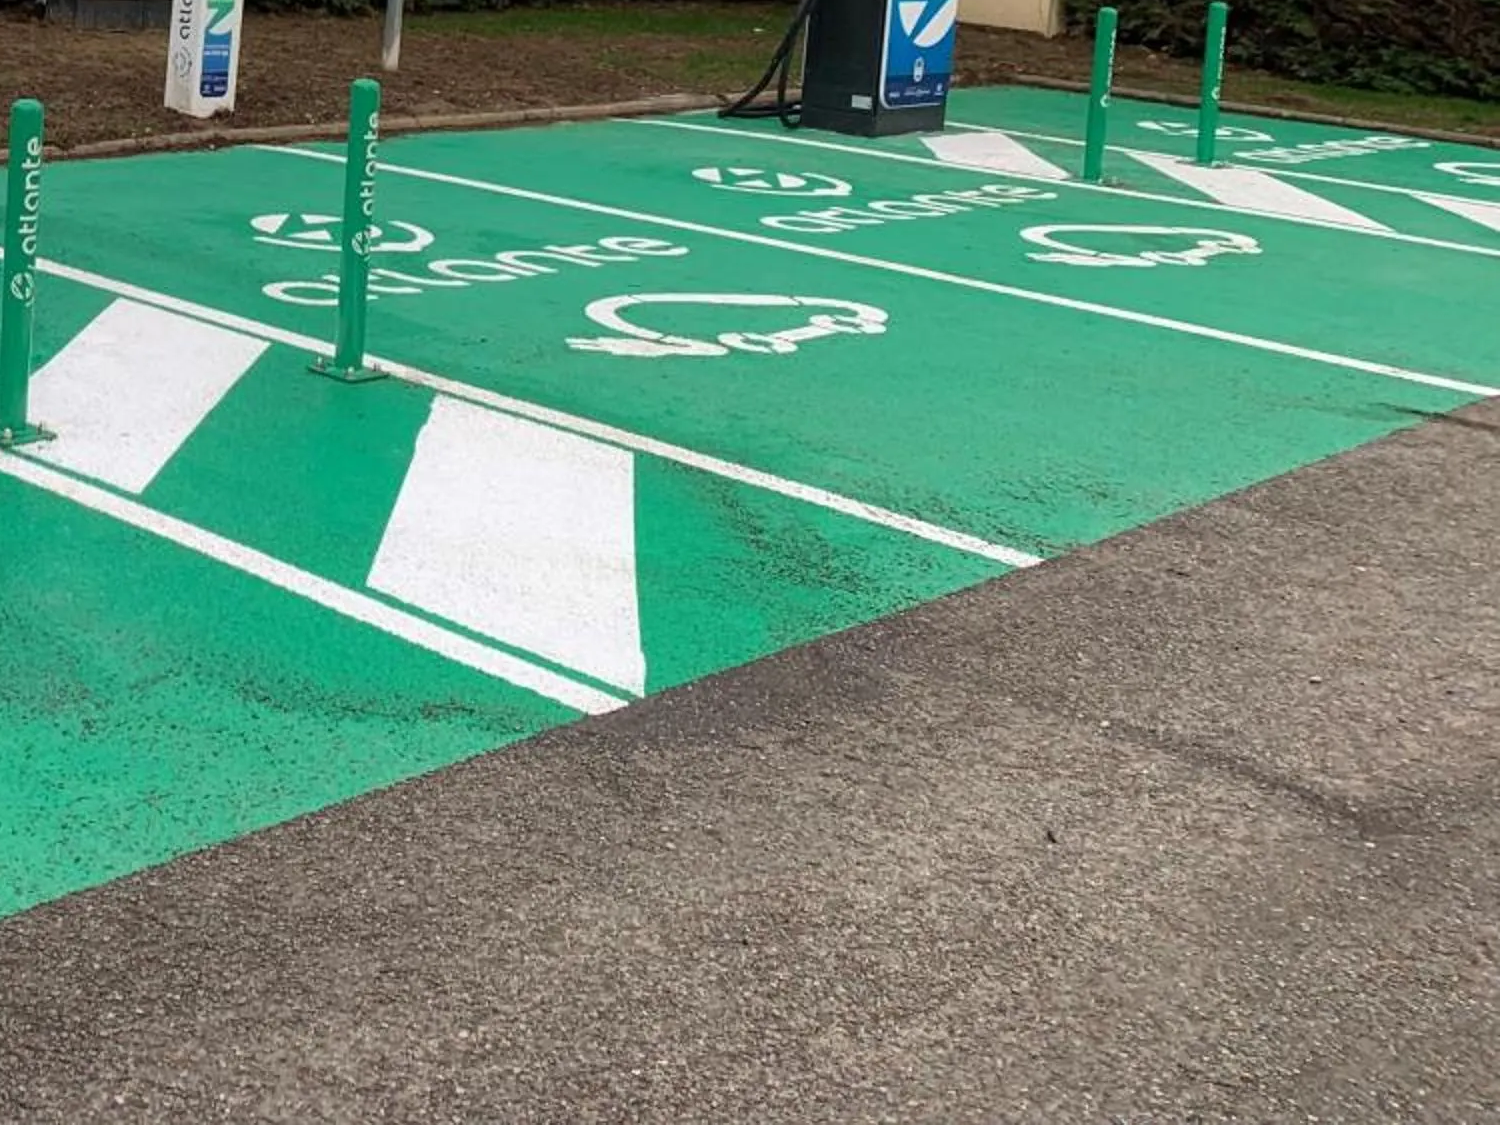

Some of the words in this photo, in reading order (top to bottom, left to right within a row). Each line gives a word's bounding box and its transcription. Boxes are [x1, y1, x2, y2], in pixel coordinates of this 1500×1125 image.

[18, 135, 42, 256] atlante
[359, 111, 380, 217] atlante
[759, 184, 1058, 233] atlante
